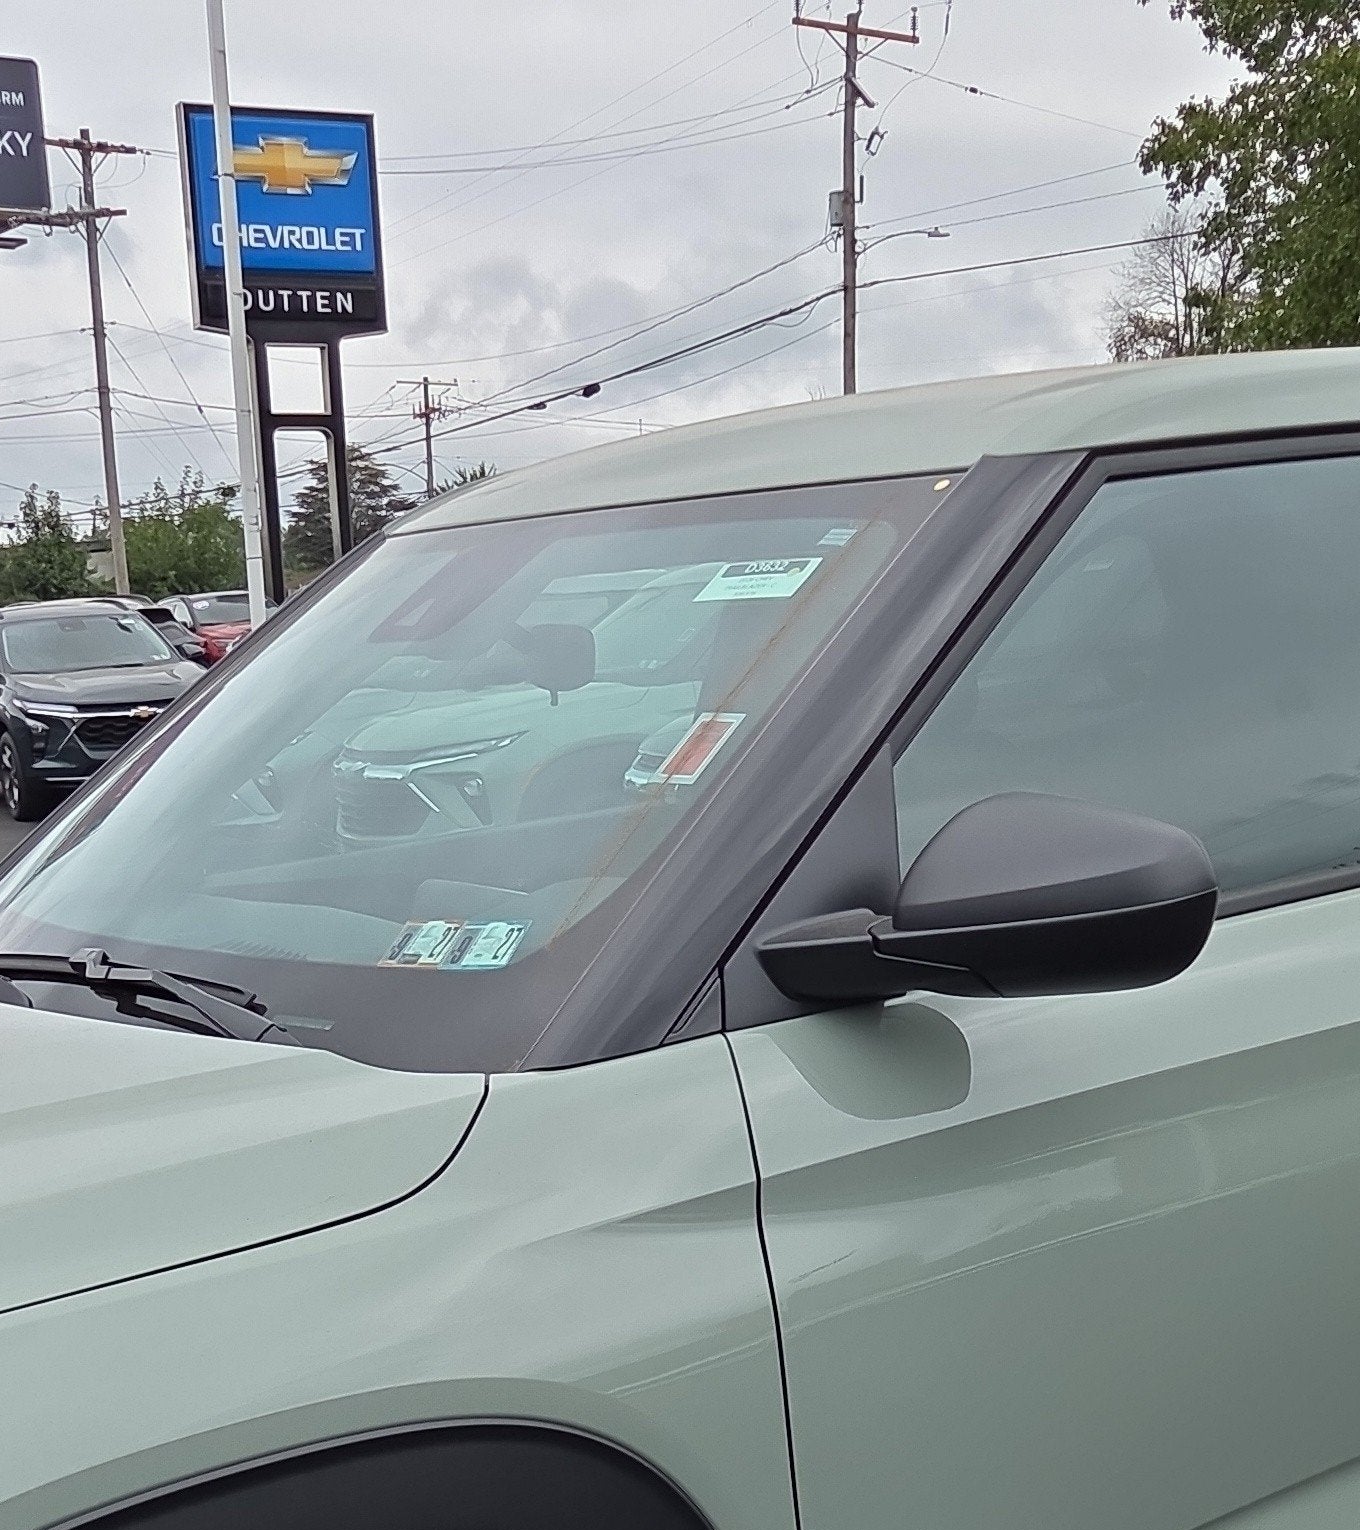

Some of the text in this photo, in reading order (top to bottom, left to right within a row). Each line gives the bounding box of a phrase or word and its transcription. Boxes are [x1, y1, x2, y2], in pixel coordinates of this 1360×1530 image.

[212, 222, 366, 251] CHEVROLET
[428, 926, 460, 959] 27
[491, 926, 523, 960] 27
